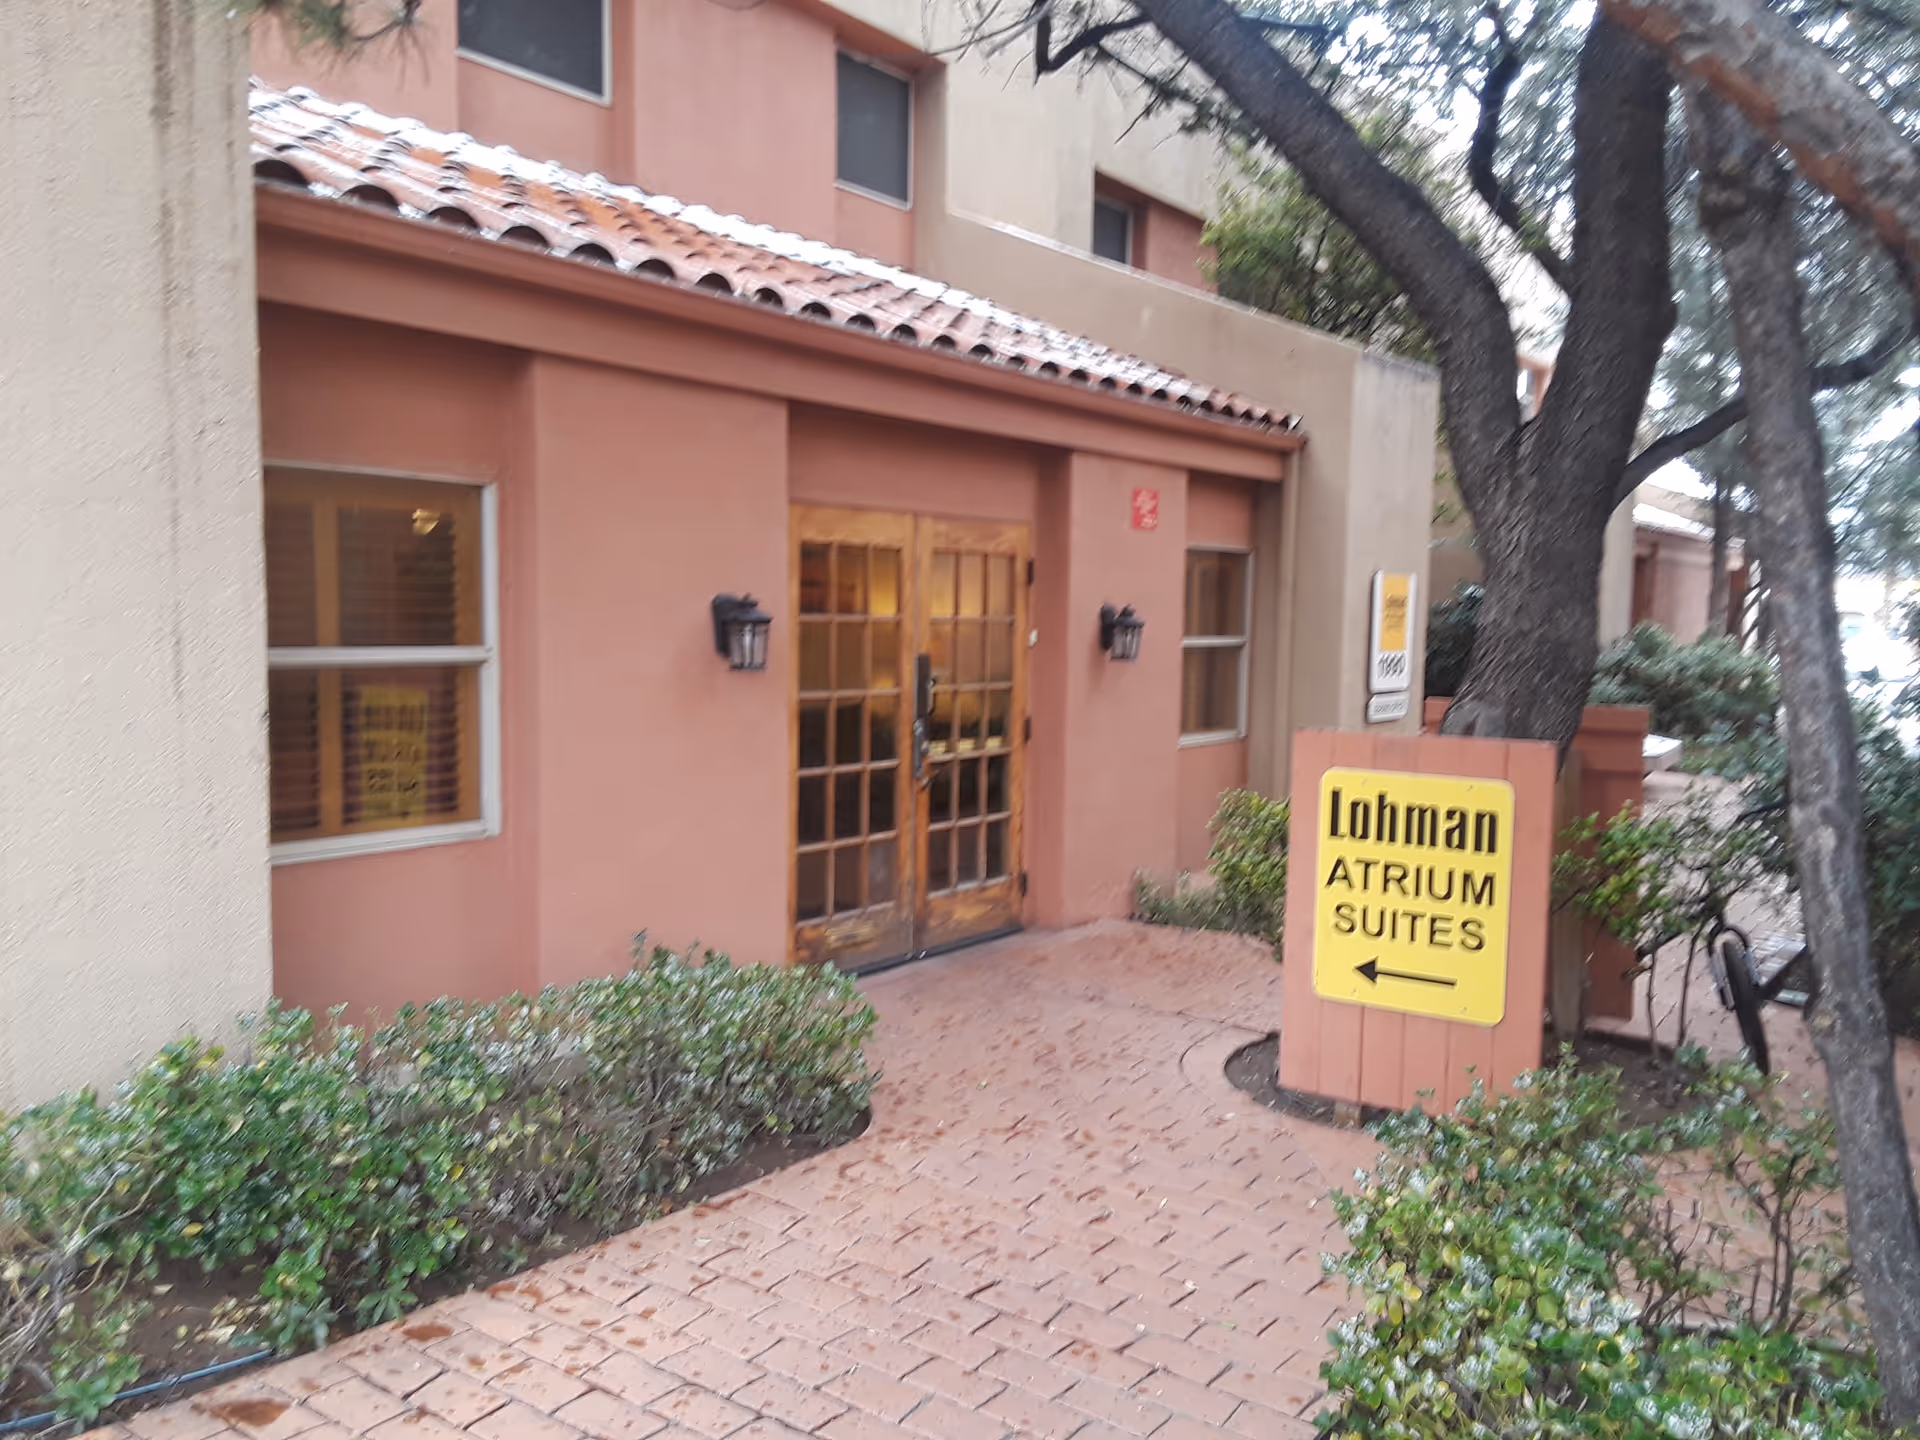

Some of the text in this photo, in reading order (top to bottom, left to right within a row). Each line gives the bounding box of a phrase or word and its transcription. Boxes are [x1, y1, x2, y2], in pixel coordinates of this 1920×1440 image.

[1329, 787, 1497, 854] Lohman
[1325, 856, 1496, 906] ATRIUM
[1334, 904, 1486, 951] SUITES
